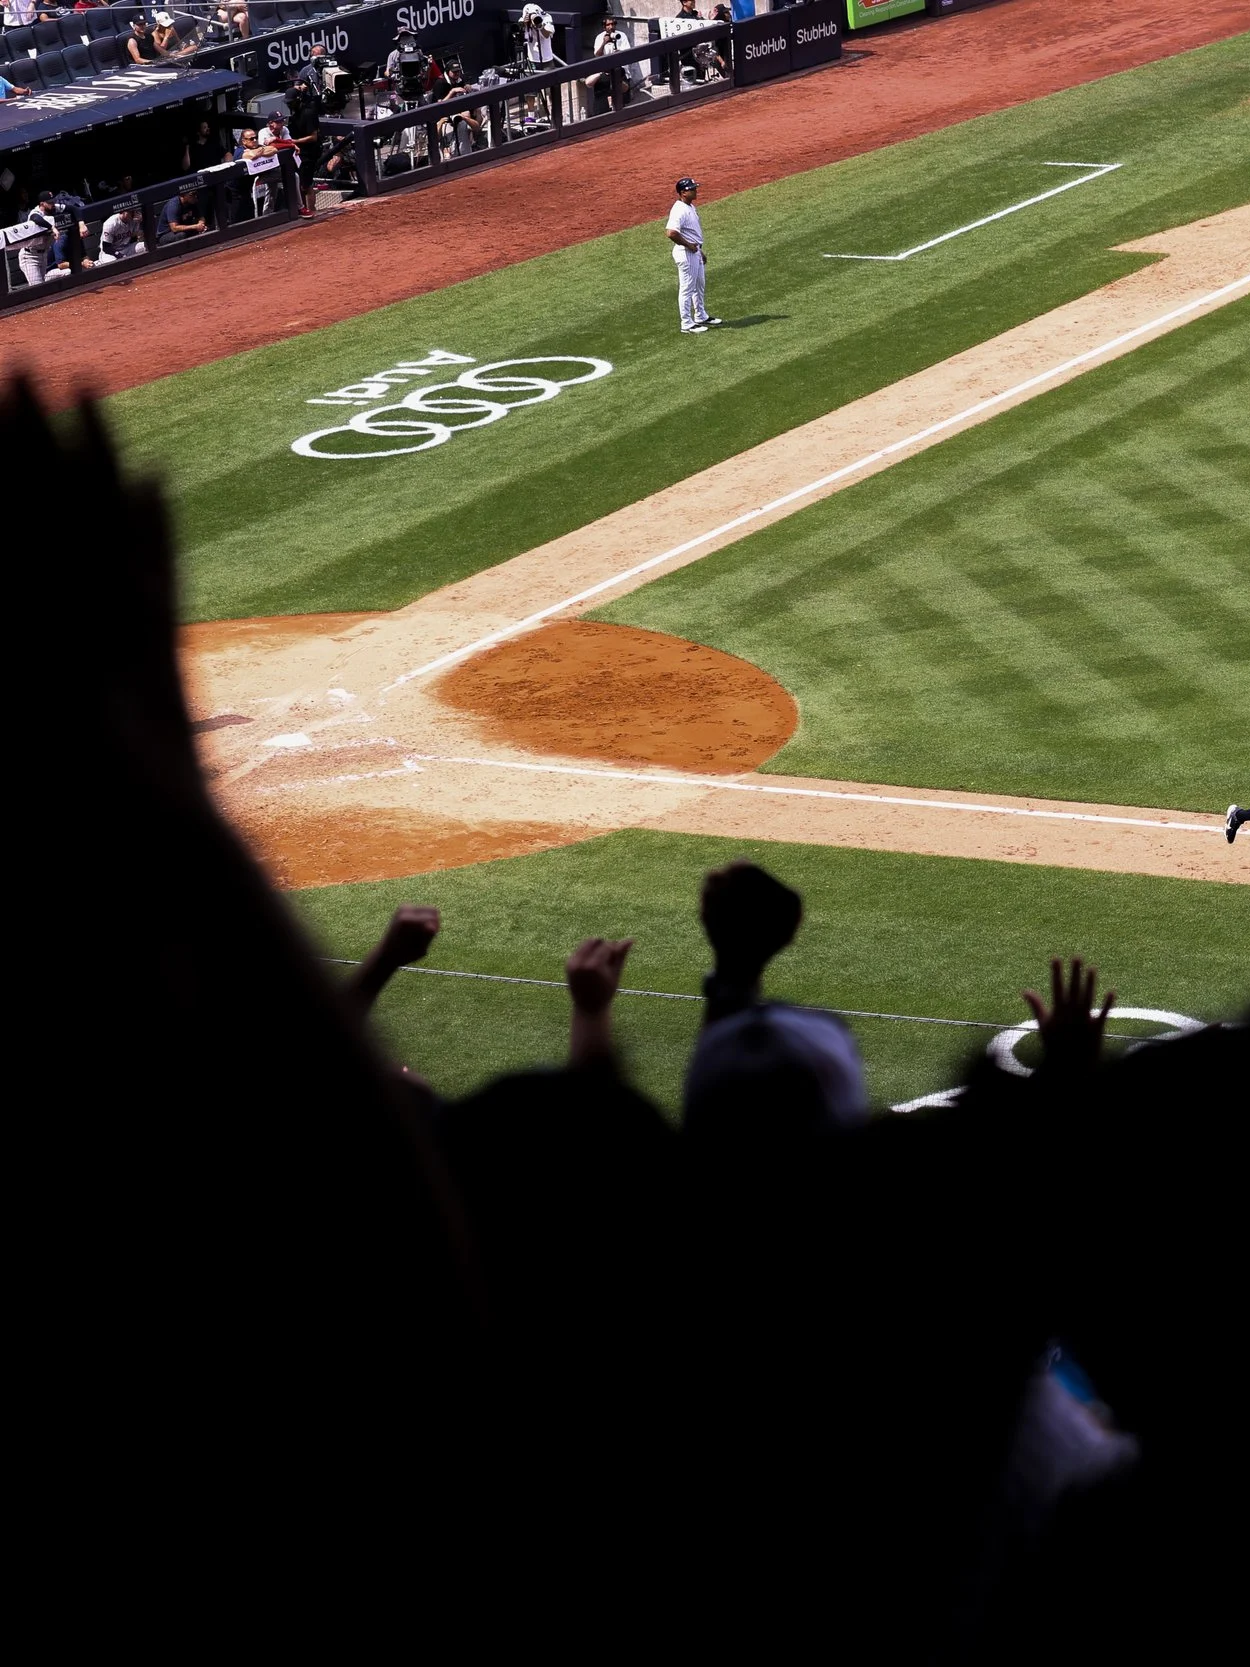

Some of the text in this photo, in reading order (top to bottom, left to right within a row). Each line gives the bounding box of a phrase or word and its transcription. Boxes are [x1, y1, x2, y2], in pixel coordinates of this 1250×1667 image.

[396, 0, 475, 31] StubHub
[267, 24, 349, 70] StubHub
[745, 35, 787, 61] StubHub
[796, 20, 838, 45] StubHub
[305, 349, 477, 406] Audi
